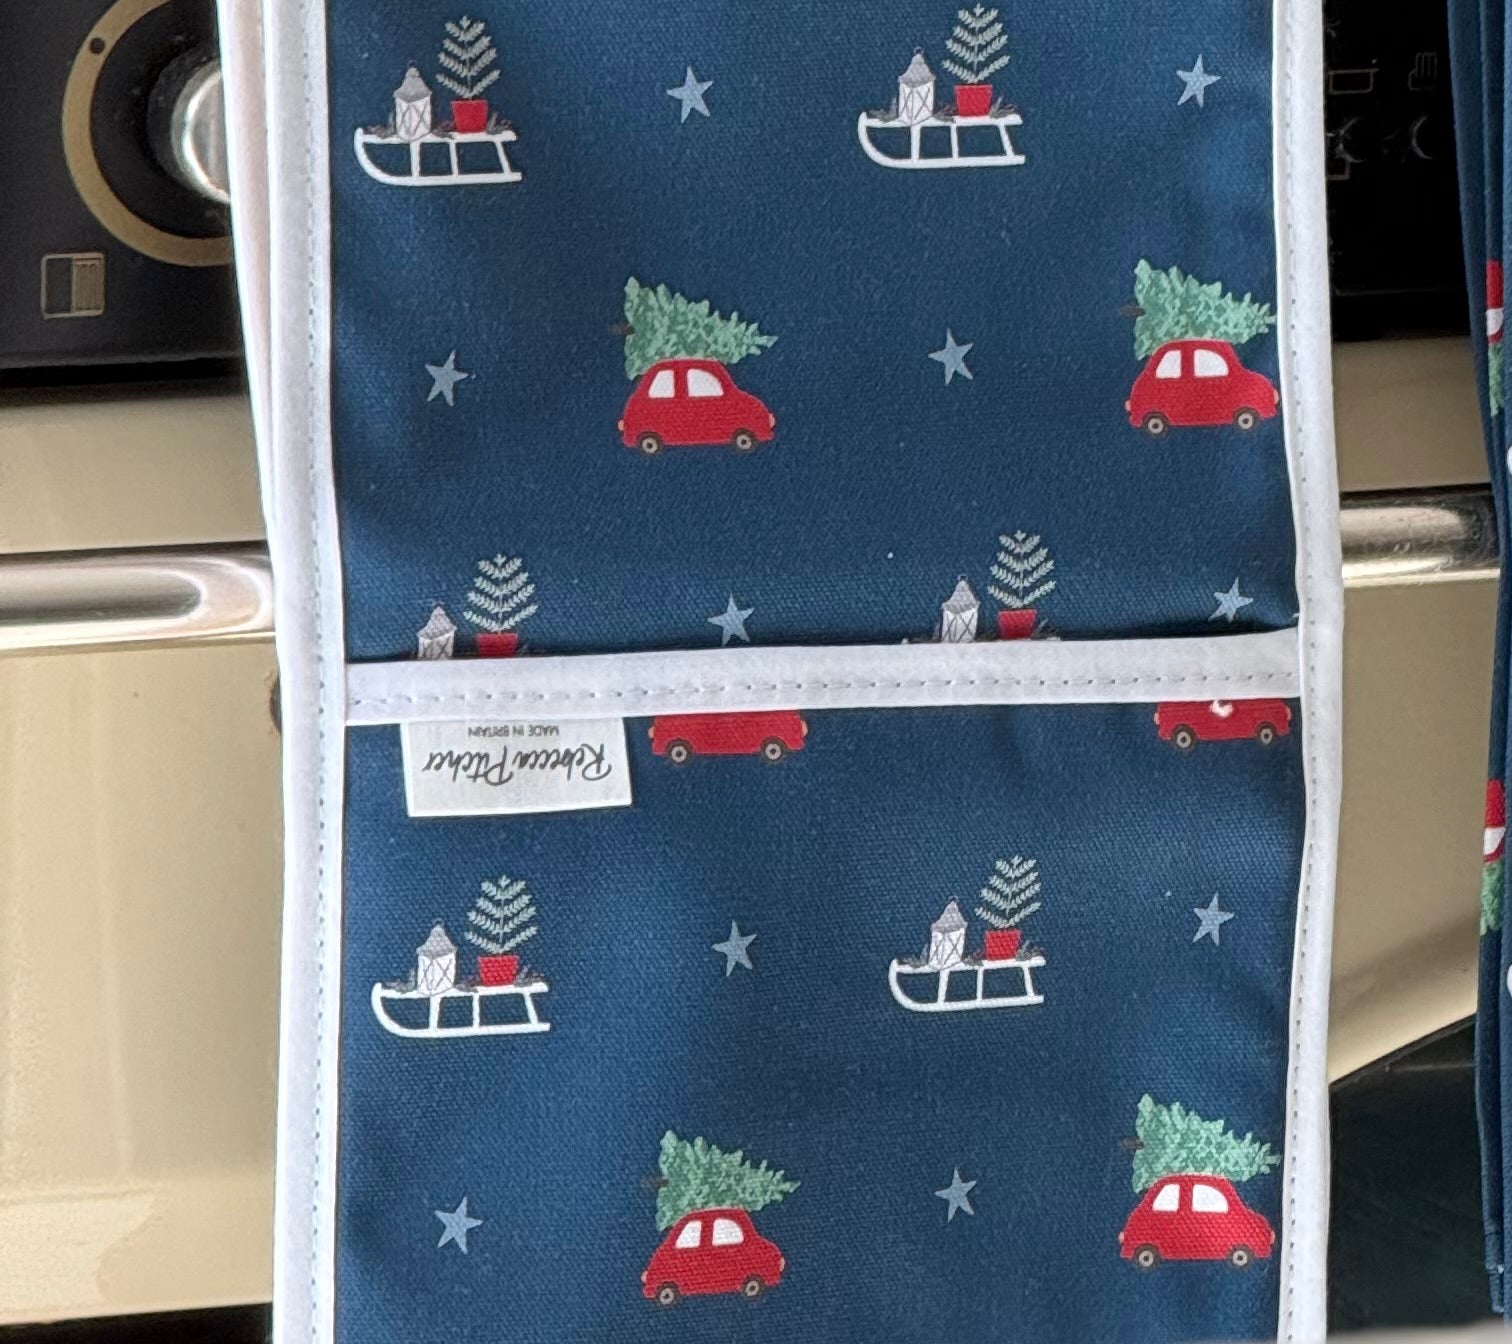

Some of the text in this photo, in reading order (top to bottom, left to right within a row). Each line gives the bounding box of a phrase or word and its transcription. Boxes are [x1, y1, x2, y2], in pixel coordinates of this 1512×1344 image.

[467, 724, 560, 737] MADE IN BRITAIN
[422, 743, 612, 787] Rebecca Pitcher
